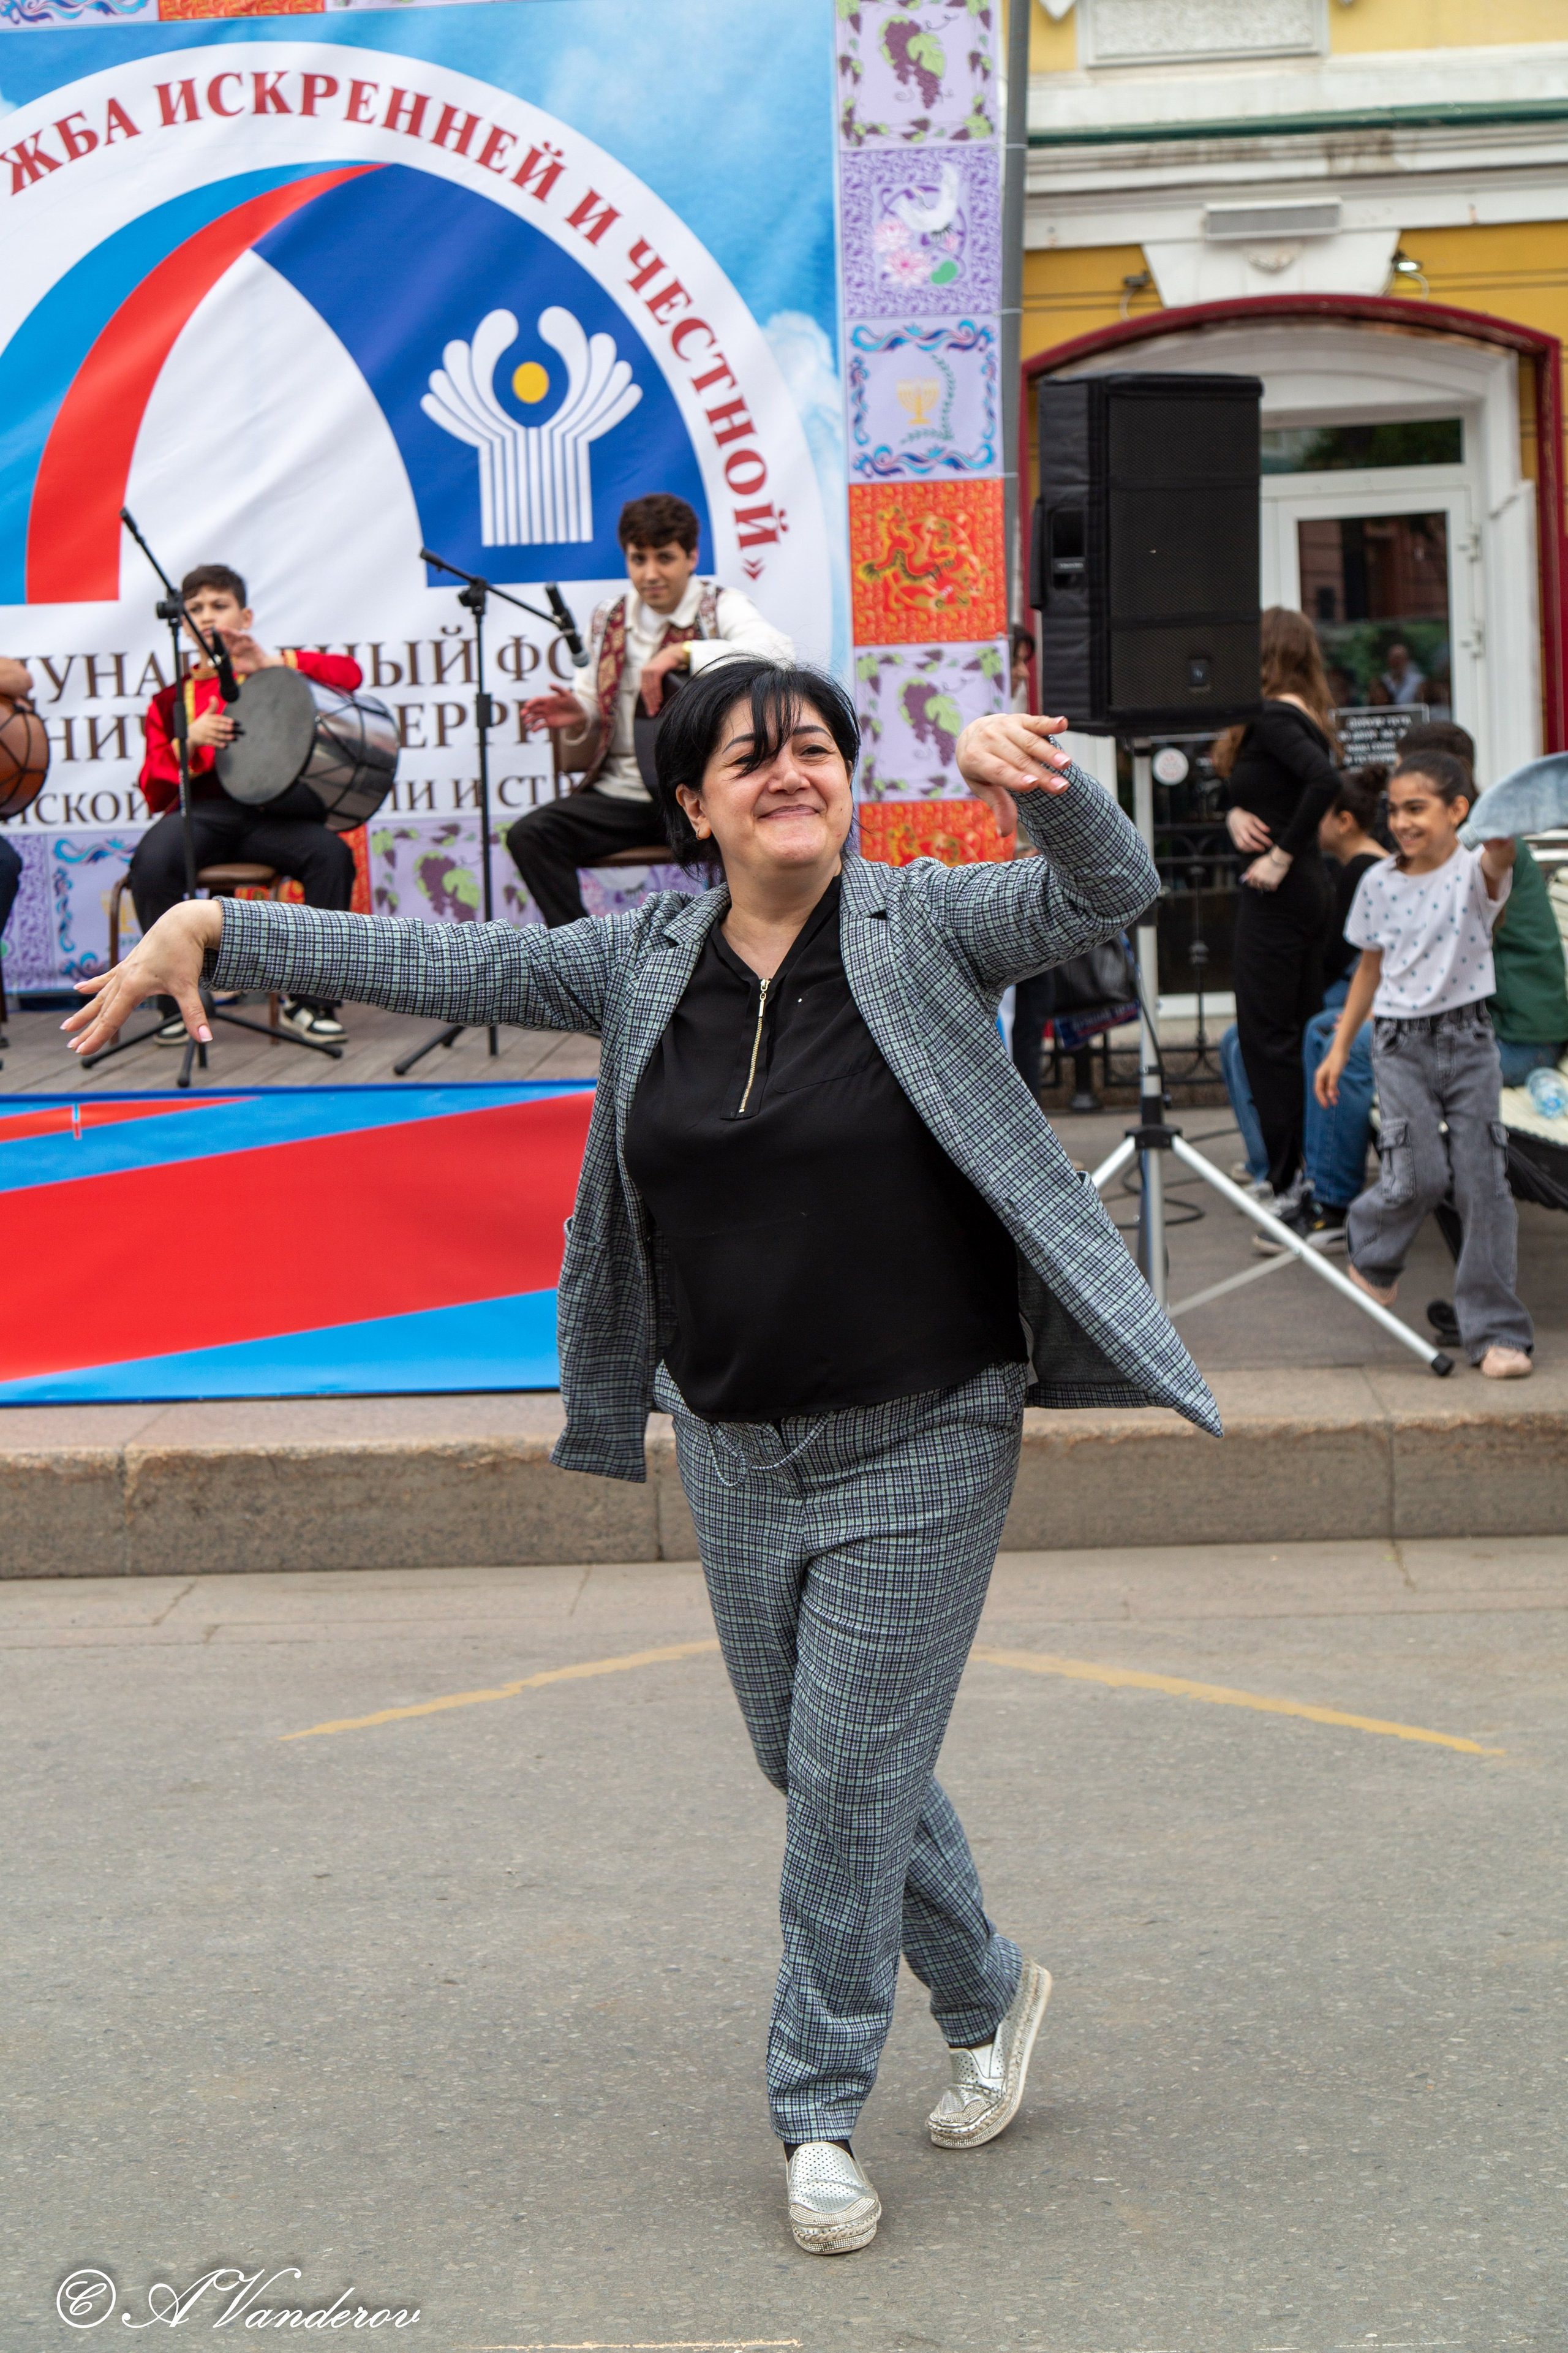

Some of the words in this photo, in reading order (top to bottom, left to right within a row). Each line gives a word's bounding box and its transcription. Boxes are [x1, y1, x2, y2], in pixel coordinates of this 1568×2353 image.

[0, 97, 141, 195] ЖБА
[154, 71, 567, 203] ИСКРЕННЕЙ
[565, 188, 624, 248] И
